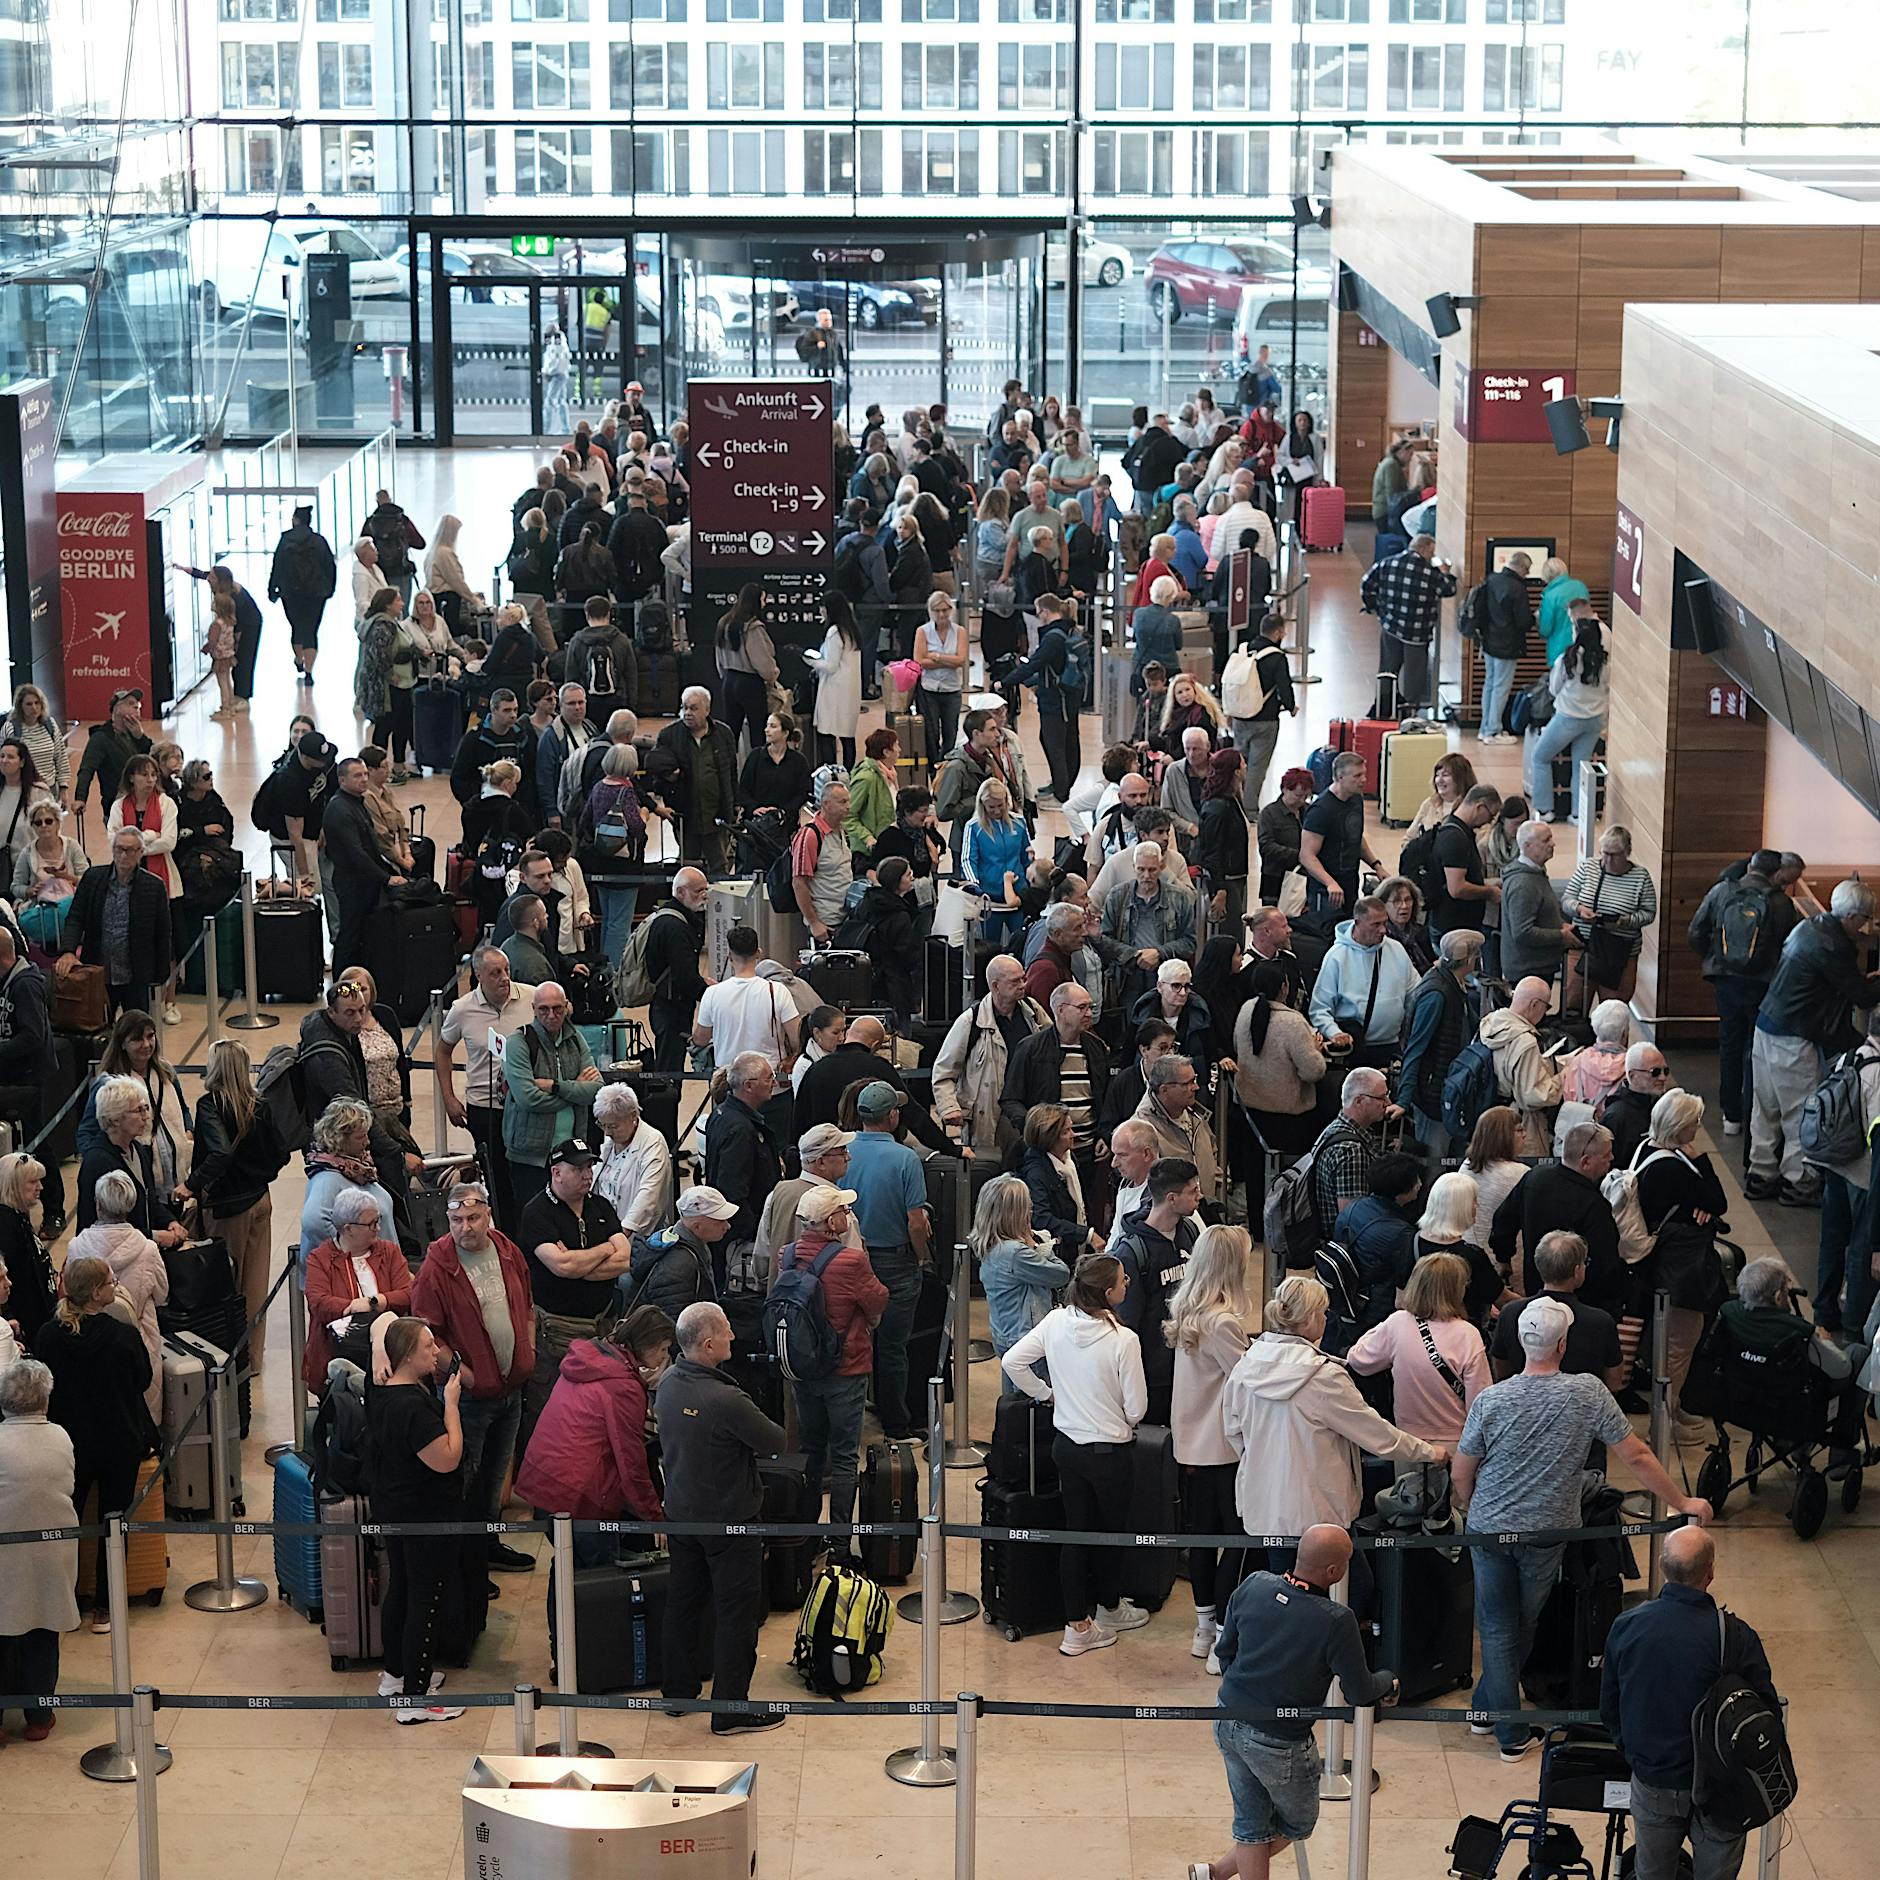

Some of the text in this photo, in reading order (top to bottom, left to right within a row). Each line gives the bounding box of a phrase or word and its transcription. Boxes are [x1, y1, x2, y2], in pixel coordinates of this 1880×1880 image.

[1484, 376, 1529, 388] Check-in
[735, 391, 798, 406] Ankunft
[760, 409, 798, 420] Arrival
[723, 439, 788, 453] Check-in
[723, 456, 734, 469] 0
[733, 482, 799, 497] Check-in
[770, 499, 799, 513] 1–9
[57, 511, 134, 537] Coca-Cola
[698, 531, 748, 542] Terminal
[753, 538, 769, 549] T2
[60, 549, 134, 561] GOODBYE
[719, 545, 737, 554] 500
[1632, 526, 1643, 597] 2
[60, 563, 136, 579] BERLIN
[92, 655, 110, 666] Fly
[72, 666, 131, 677] refreshed!
[1441, 1158, 1457, 1166] BER
[234, 1524, 255, 1534] BER
[361, 1524, 381, 1534] BER
[486, 1523, 506, 1533] BER
[600, 1522, 620, 1532] BER
[726, 1525, 747, 1535] BER
[852, 1524, 872, 1534] BER
[1621, 1524, 1641, 1535] BER
[41, 1530, 62, 1540] BER
[1009, 1530, 1029, 1540] BER
[1136, 1535, 1156, 1546] BER
[1498, 1534, 1519, 1544] BER
[1263, 1537, 1283, 1548] BER
[1375, 1538, 1395, 1548] BER
[38, 1696, 60, 1707] BER
[248, 1698, 270, 1708] BER
[389, 1696, 412, 1707] BER
[628, 1698, 650, 1709] BER
[768, 1702, 790, 1713] BER
[909, 1702, 931, 1713] BER
[1136, 1708, 1157, 1718] BER
[1276, 1707, 1298, 1718] BER
[1466, 1710, 1488, 1722] BER
[660, 1839, 695, 1854] BER
